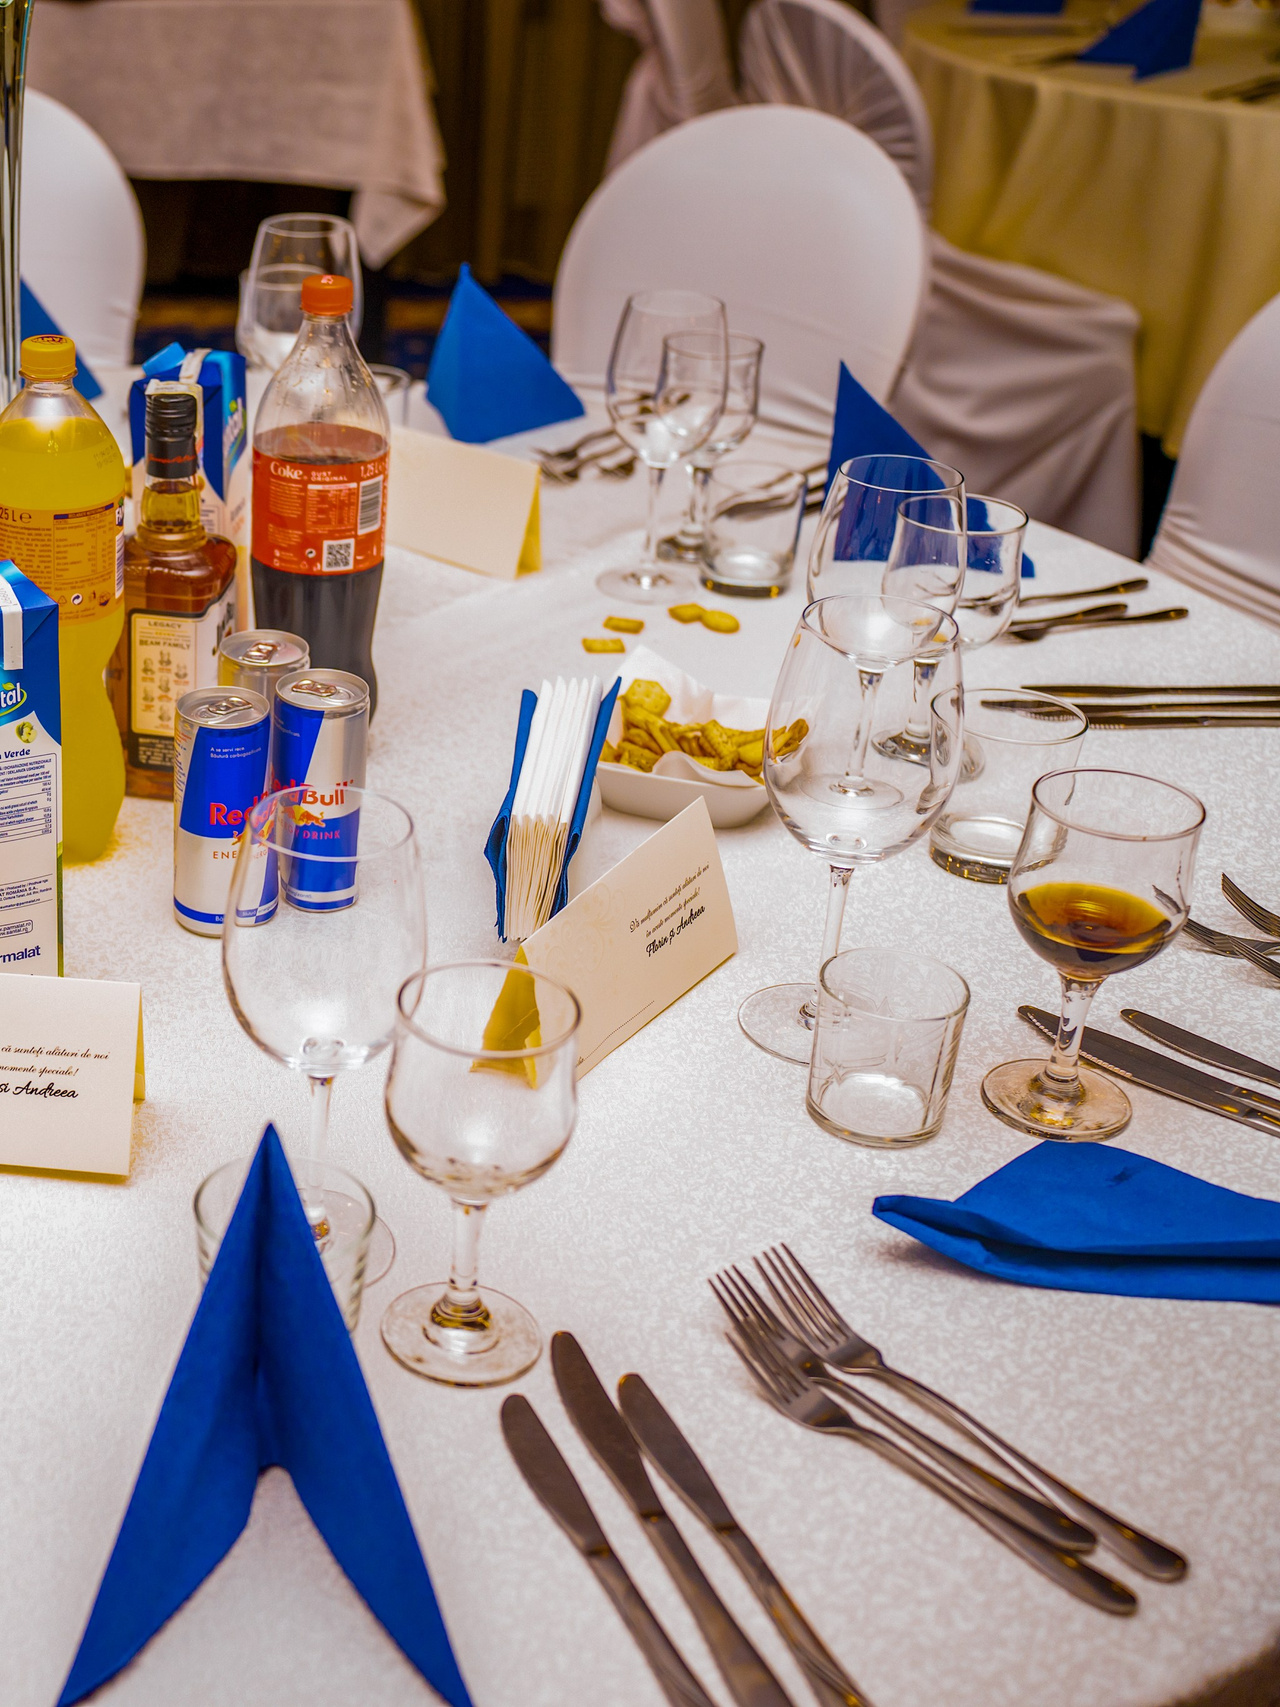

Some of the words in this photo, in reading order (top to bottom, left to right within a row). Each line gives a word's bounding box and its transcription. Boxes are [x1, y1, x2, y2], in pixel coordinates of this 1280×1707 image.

[270, 461, 303, 480] Coke
[148, 620, 182, 629] LEGACY
[139, 639, 161, 647] BEAM
[162, 641, 191, 650] FAMILY
[4, 748, 31, 759] Verde
[300, 780, 348, 806] Bull
[303, 830, 341, 840] DRINK
[645, 937, 669, 957] Florin
[676, 905, 706, 935] Andreea
[1, 1045, 12, 1053] că
[80, 1048, 92, 1059] de
[93, 1051, 110, 1060] noi
[38, 1066, 80, 1077] speciale!
[12, 1080, 79, 1099] Andreea
